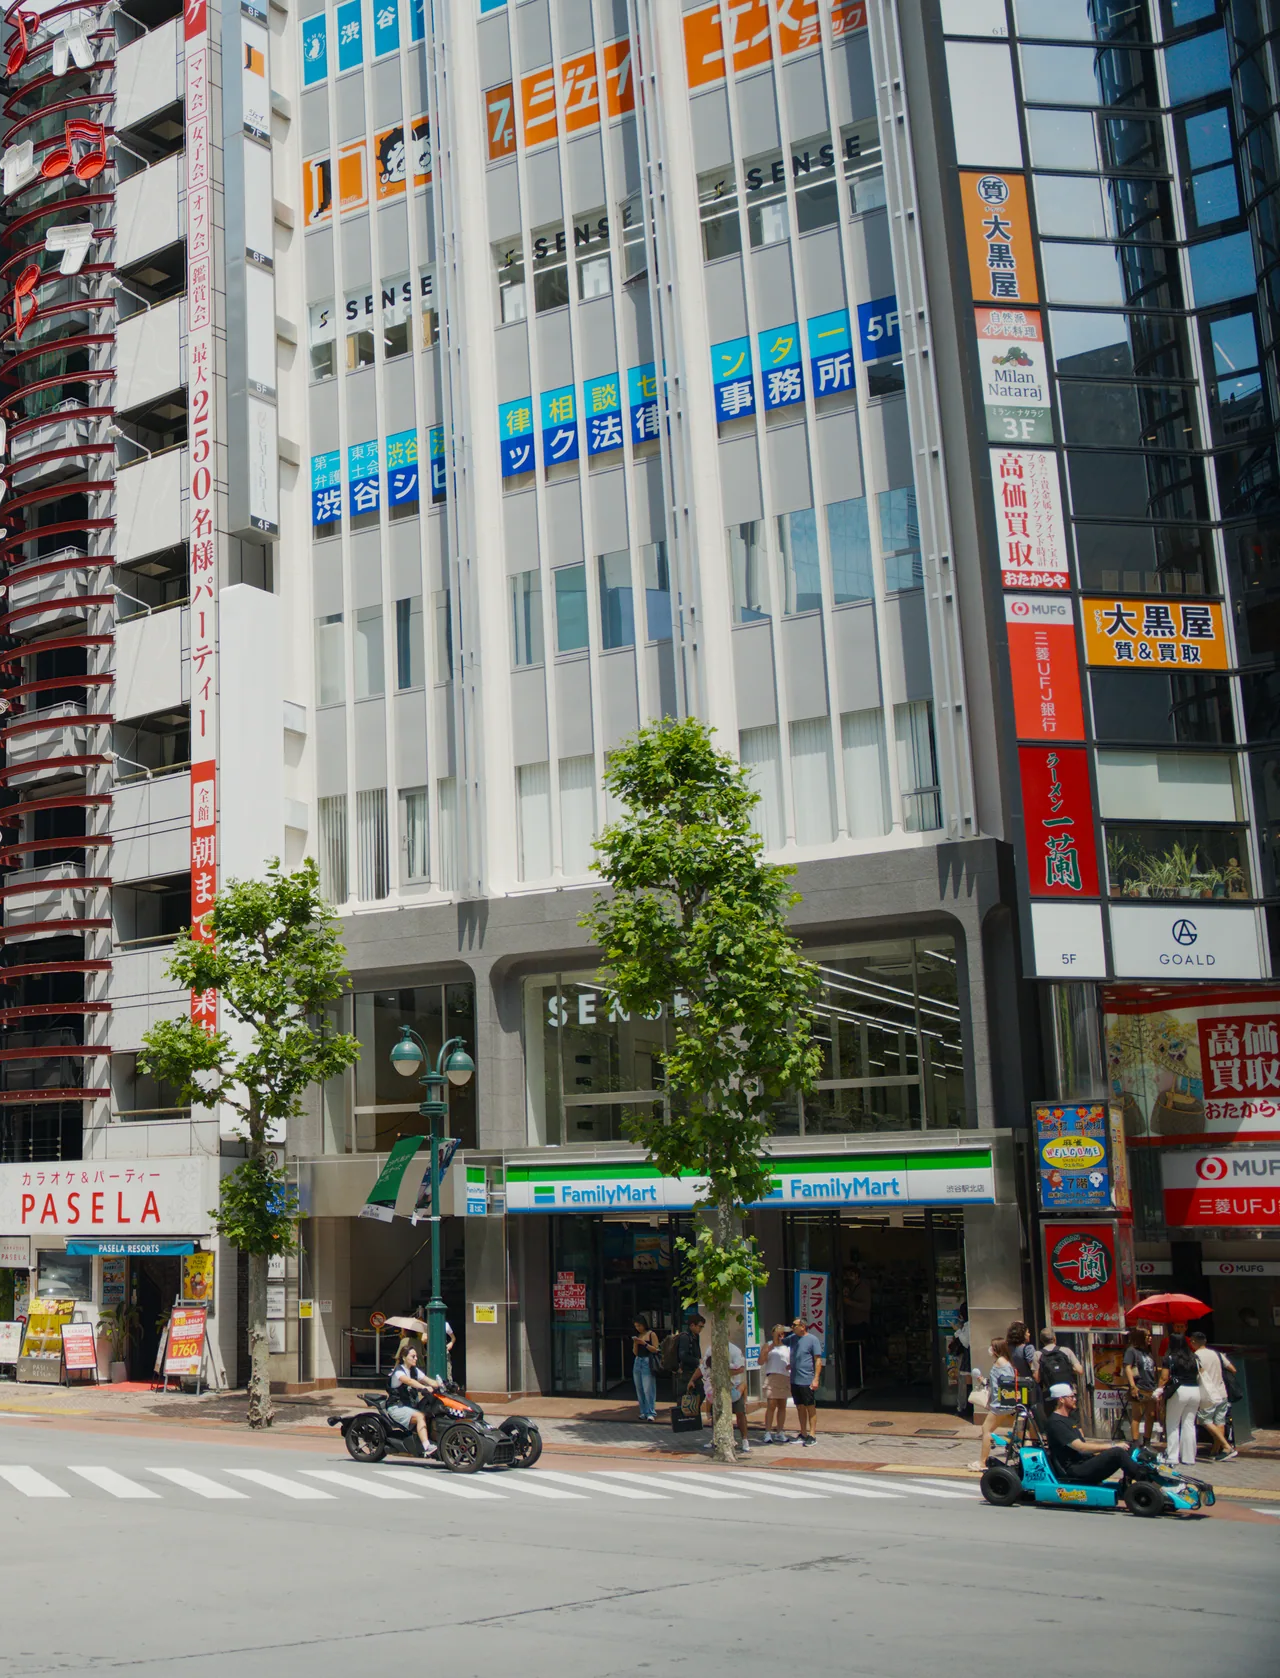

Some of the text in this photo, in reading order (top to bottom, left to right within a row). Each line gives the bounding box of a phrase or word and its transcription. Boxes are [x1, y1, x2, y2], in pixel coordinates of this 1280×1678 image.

[248, 7, 259, 17] 8F
[191, 58, 203, 111] ママ会
[251, 126, 262, 138] 7F
[488, 97, 514, 149] 7F
[193, 126, 205, 181] 女子会
[748, 135, 862, 192] SENSE
[193, 195, 205, 248] オフ会
[534, 205, 632, 260] SENSE
[253, 251, 265, 264] 6F
[983, 214, 1020, 299] 大黒屋
[193, 264, 207, 323] 鑑賞会
[346, 275, 433, 321] SENSE
[867, 314, 898, 342] 5F
[990, 312, 1026, 324] 自然派
[983, 325, 1036, 338] インド料理
[994, 369, 1035, 384] Milan
[988, 383, 1042, 401] Nataraj
[1003, 418, 1035, 439] 3F
[998, 452, 1034, 567] 高価買取
[258, 519, 269, 531] 4F
[1004, 571, 1067, 588] おたからや
[1031, 604, 1066, 616] MUFG
[1102, 603, 1215, 640] 大黒屋
[1034, 631, 1057, 732] 三菱UFJ銀行
[198, 788, 210, 822] 全館
[1042, 753, 1082, 891] ラーメン 一蘭
[1062, 953, 1077, 965] 5F
[1159, 953, 1216, 966] GOALD
[1206, 1021, 1280, 1058] 高価
[1210, 1056, 1280, 1093] 買取
[1205, 1101, 1280, 1120] おたから
[1046, 1146, 1101, 1158] WELCOME
[467, 1186, 485, 1195] FamilyMart
[790, 1177, 900, 1200] FamilyMart
[946, 1184, 985, 1194] 渋谷駅北店
[1066, 1178, 1088, 1189] 7階
[562, 1185, 657, 1205] FamilyMart
[21, 1190, 161, 1225] PASELA
[1199, 1198, 1280, 1215] 三菱UFJ
[1, 1253, 27, 1261] PASELA
[98, 1244, 160, 1253] PASELA RESORTS
[1054, 1241, 1108, 1283] 一蘭
[1236, 1264, 1264, 1273] MUFG
[809, 1276, 824, 1334] フラッペ
